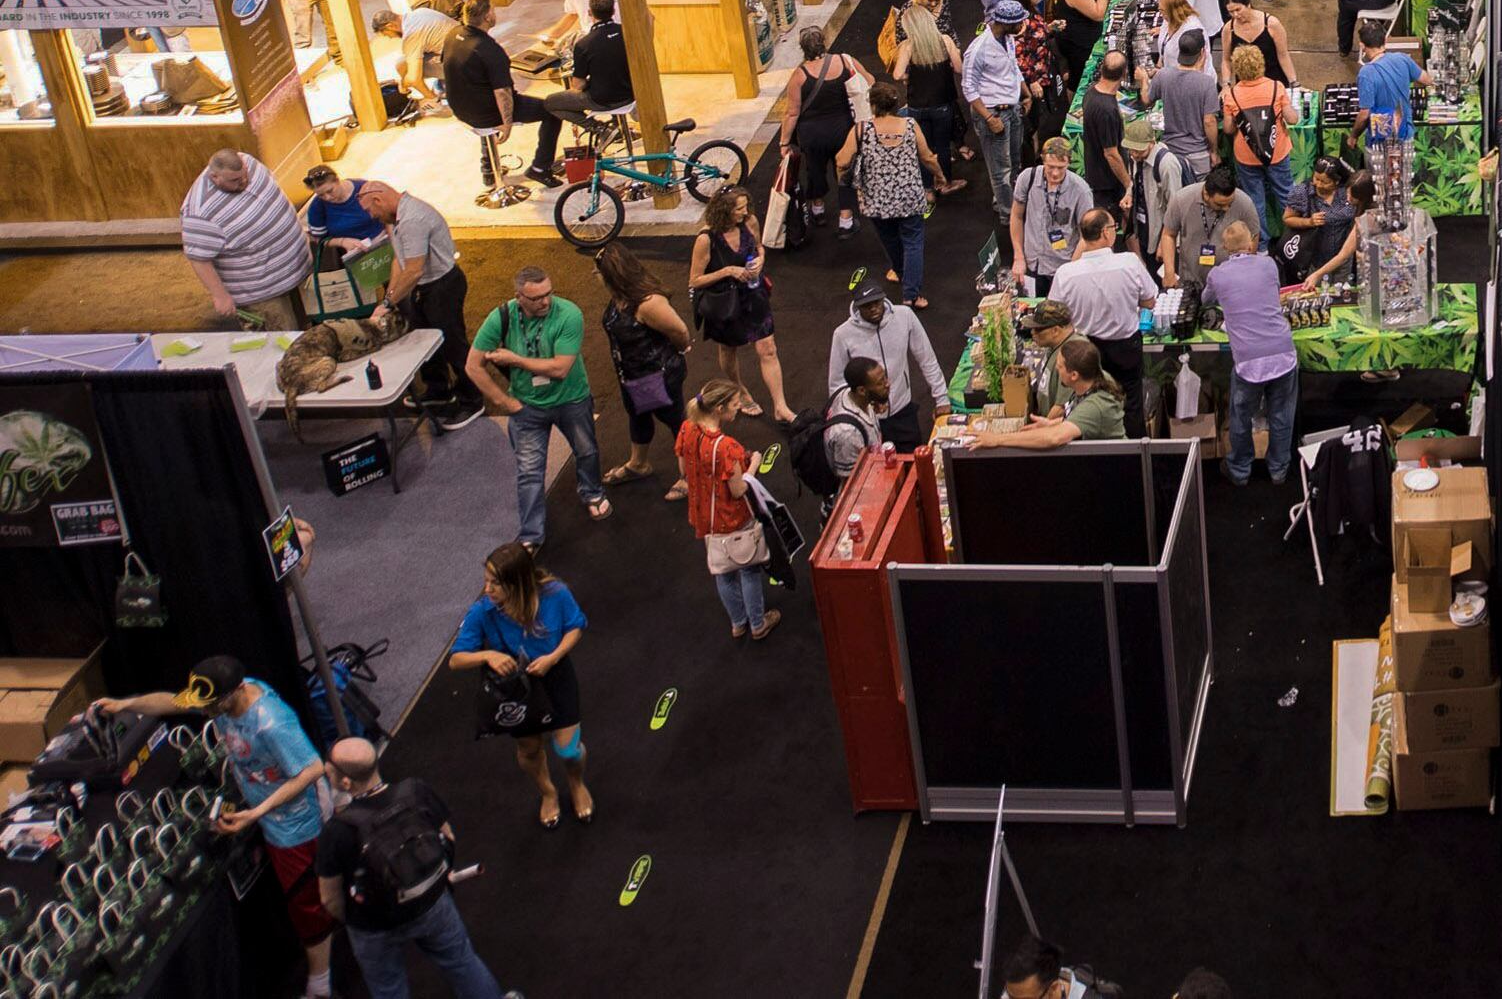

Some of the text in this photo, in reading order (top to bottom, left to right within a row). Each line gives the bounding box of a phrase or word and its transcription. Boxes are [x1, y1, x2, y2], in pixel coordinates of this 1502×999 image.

[26, 12, 35, 21] IN
[40, 12, 57, 21] THE
[60, 11, 110, 21] INDUSTRY
[113, 11, 143, 20] SINCE
[146, 10, 170, 19] 1998
[339, 453, 358, 468] THE
[340, 454, 377, 475] FUTURE
[343, 472, 357, 483] OF
[345, 469, 384, 492] ROLLING
[56, 503, 116, 519] GRAB BAG
